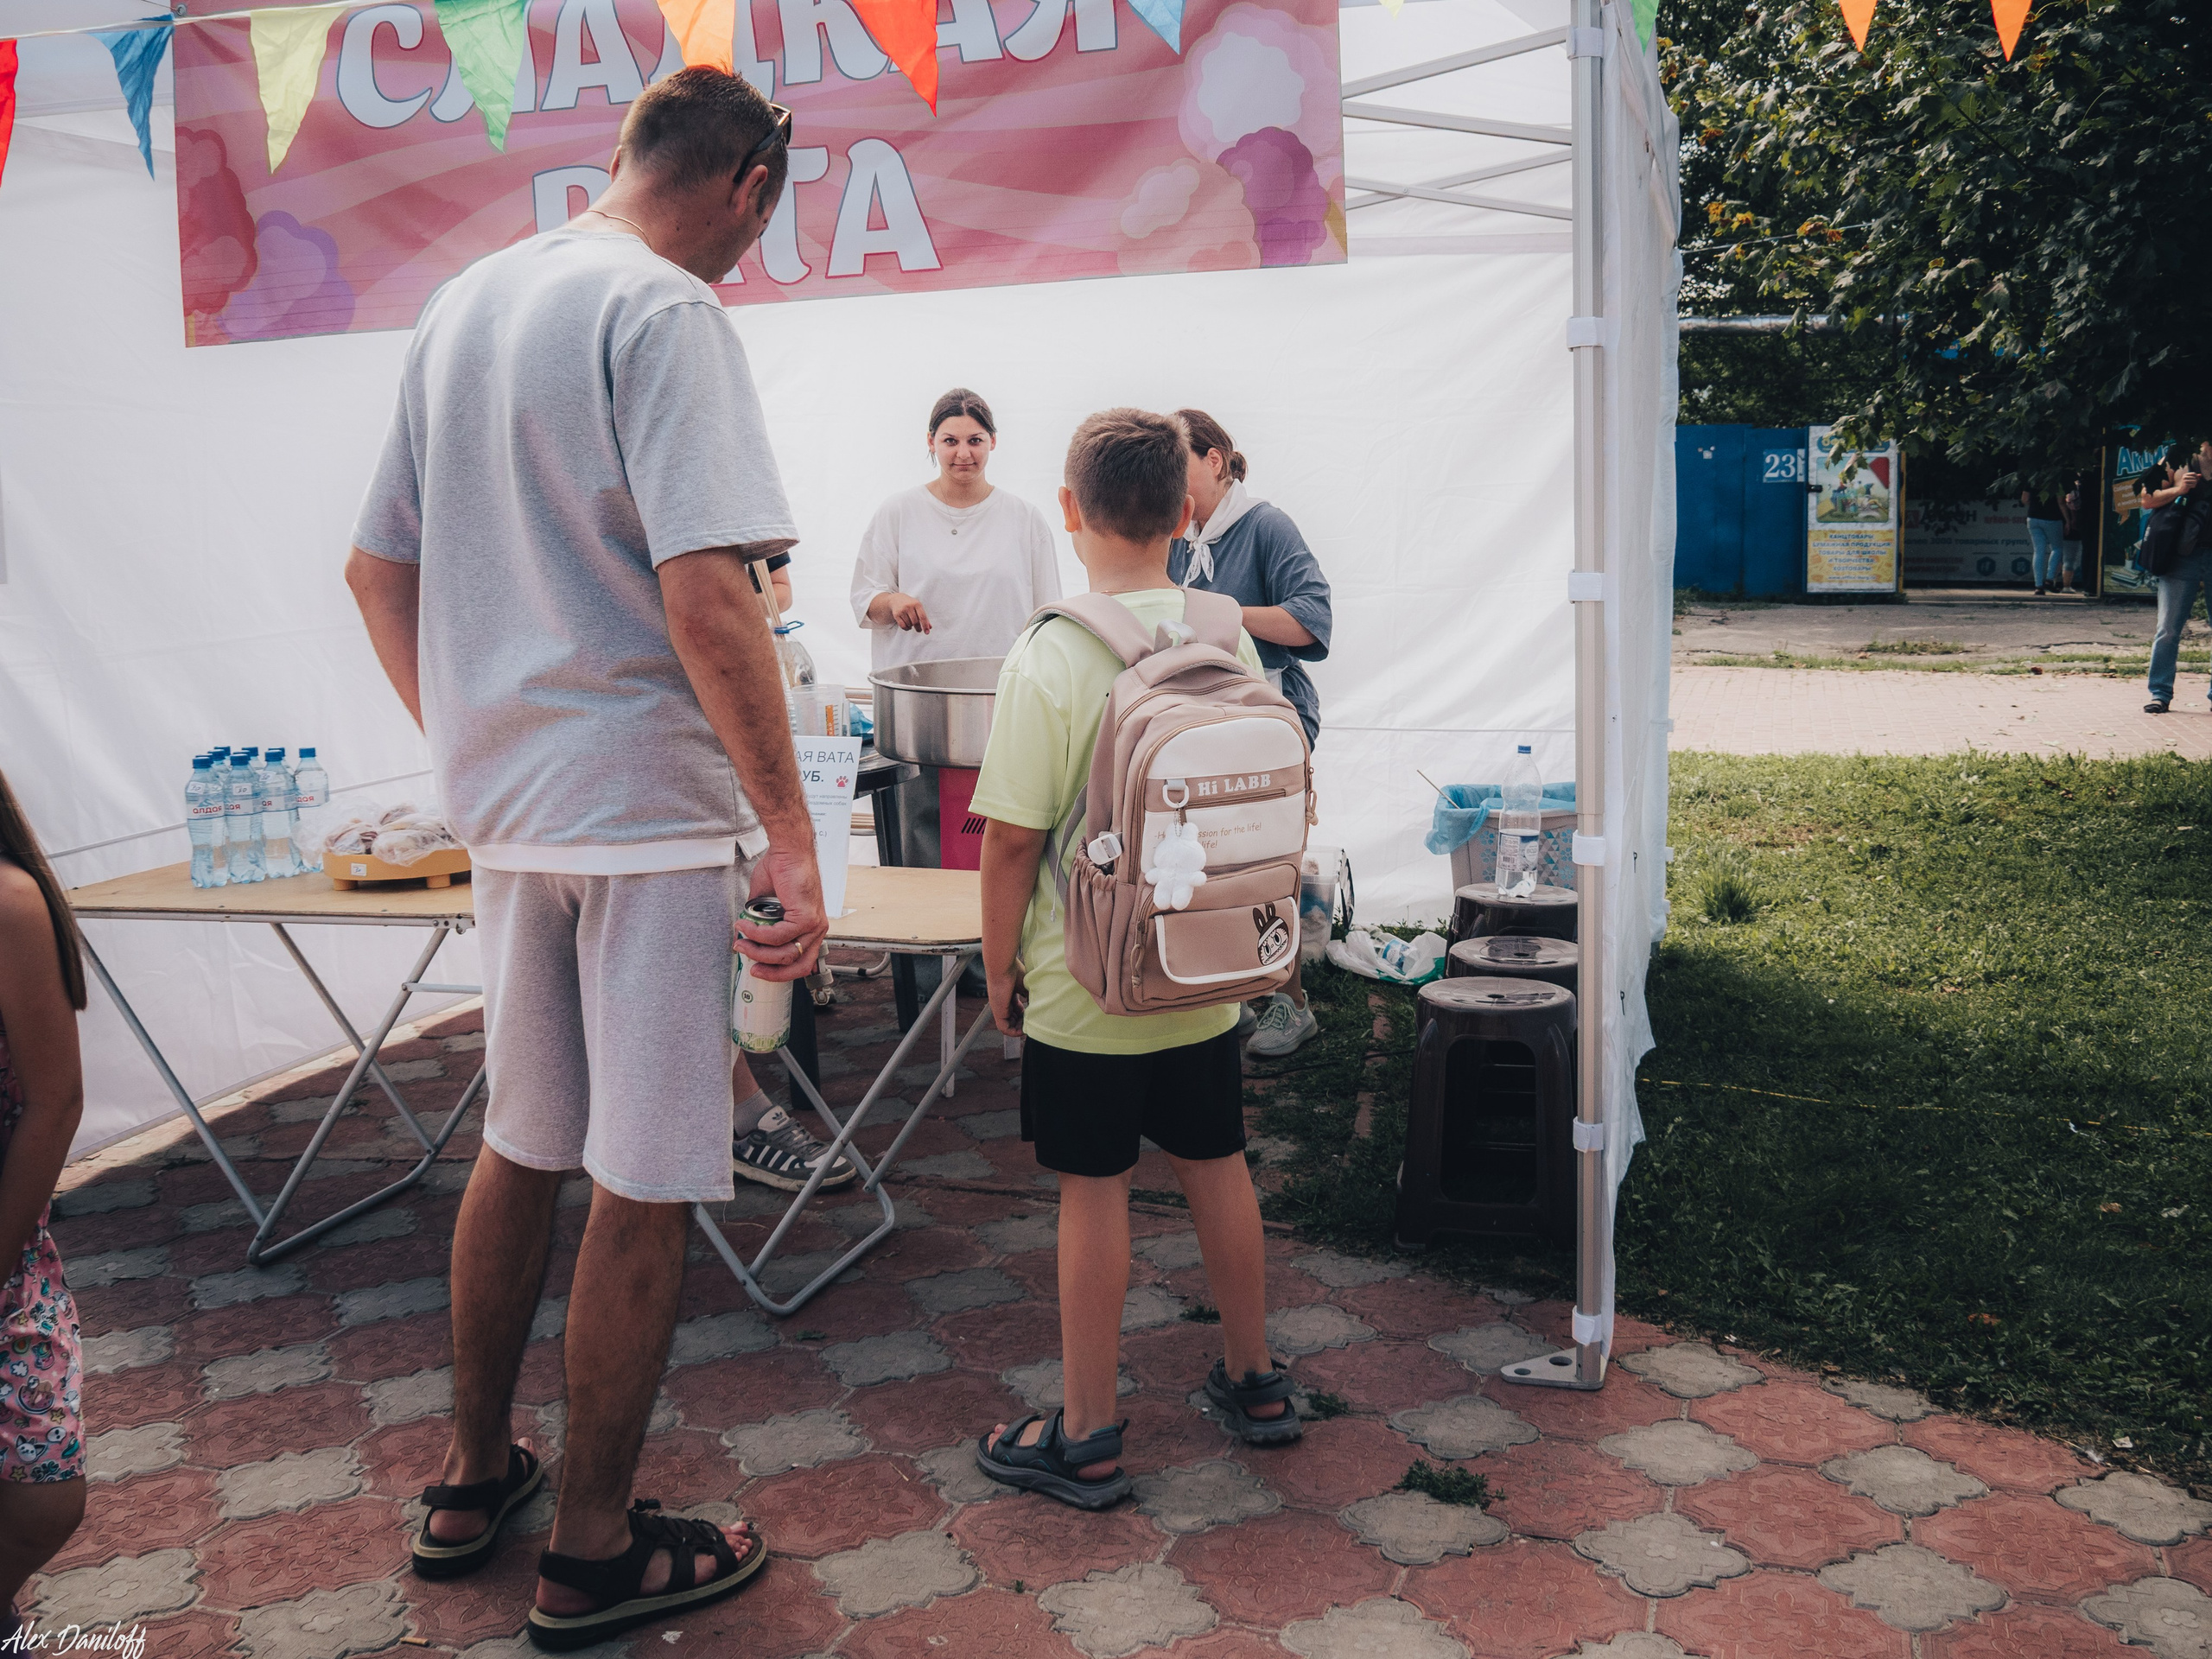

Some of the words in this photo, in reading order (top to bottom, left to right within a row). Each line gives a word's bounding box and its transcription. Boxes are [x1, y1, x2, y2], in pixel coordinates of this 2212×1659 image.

[1764, 454, 1796, 478] 23
[817, 751, 855, 763] ВАТА
[803, 771, 824, 782] УБ.
[1198, 780, 1217, 796] Hi
[1224, 773, 1271, 792] LABB
[1198, 830, 1218, 838] ssion
[1220, 828, 1231, 837] for
[1234, 824, 1245, 834] the
[1247, 822, 1262, 832] life!
